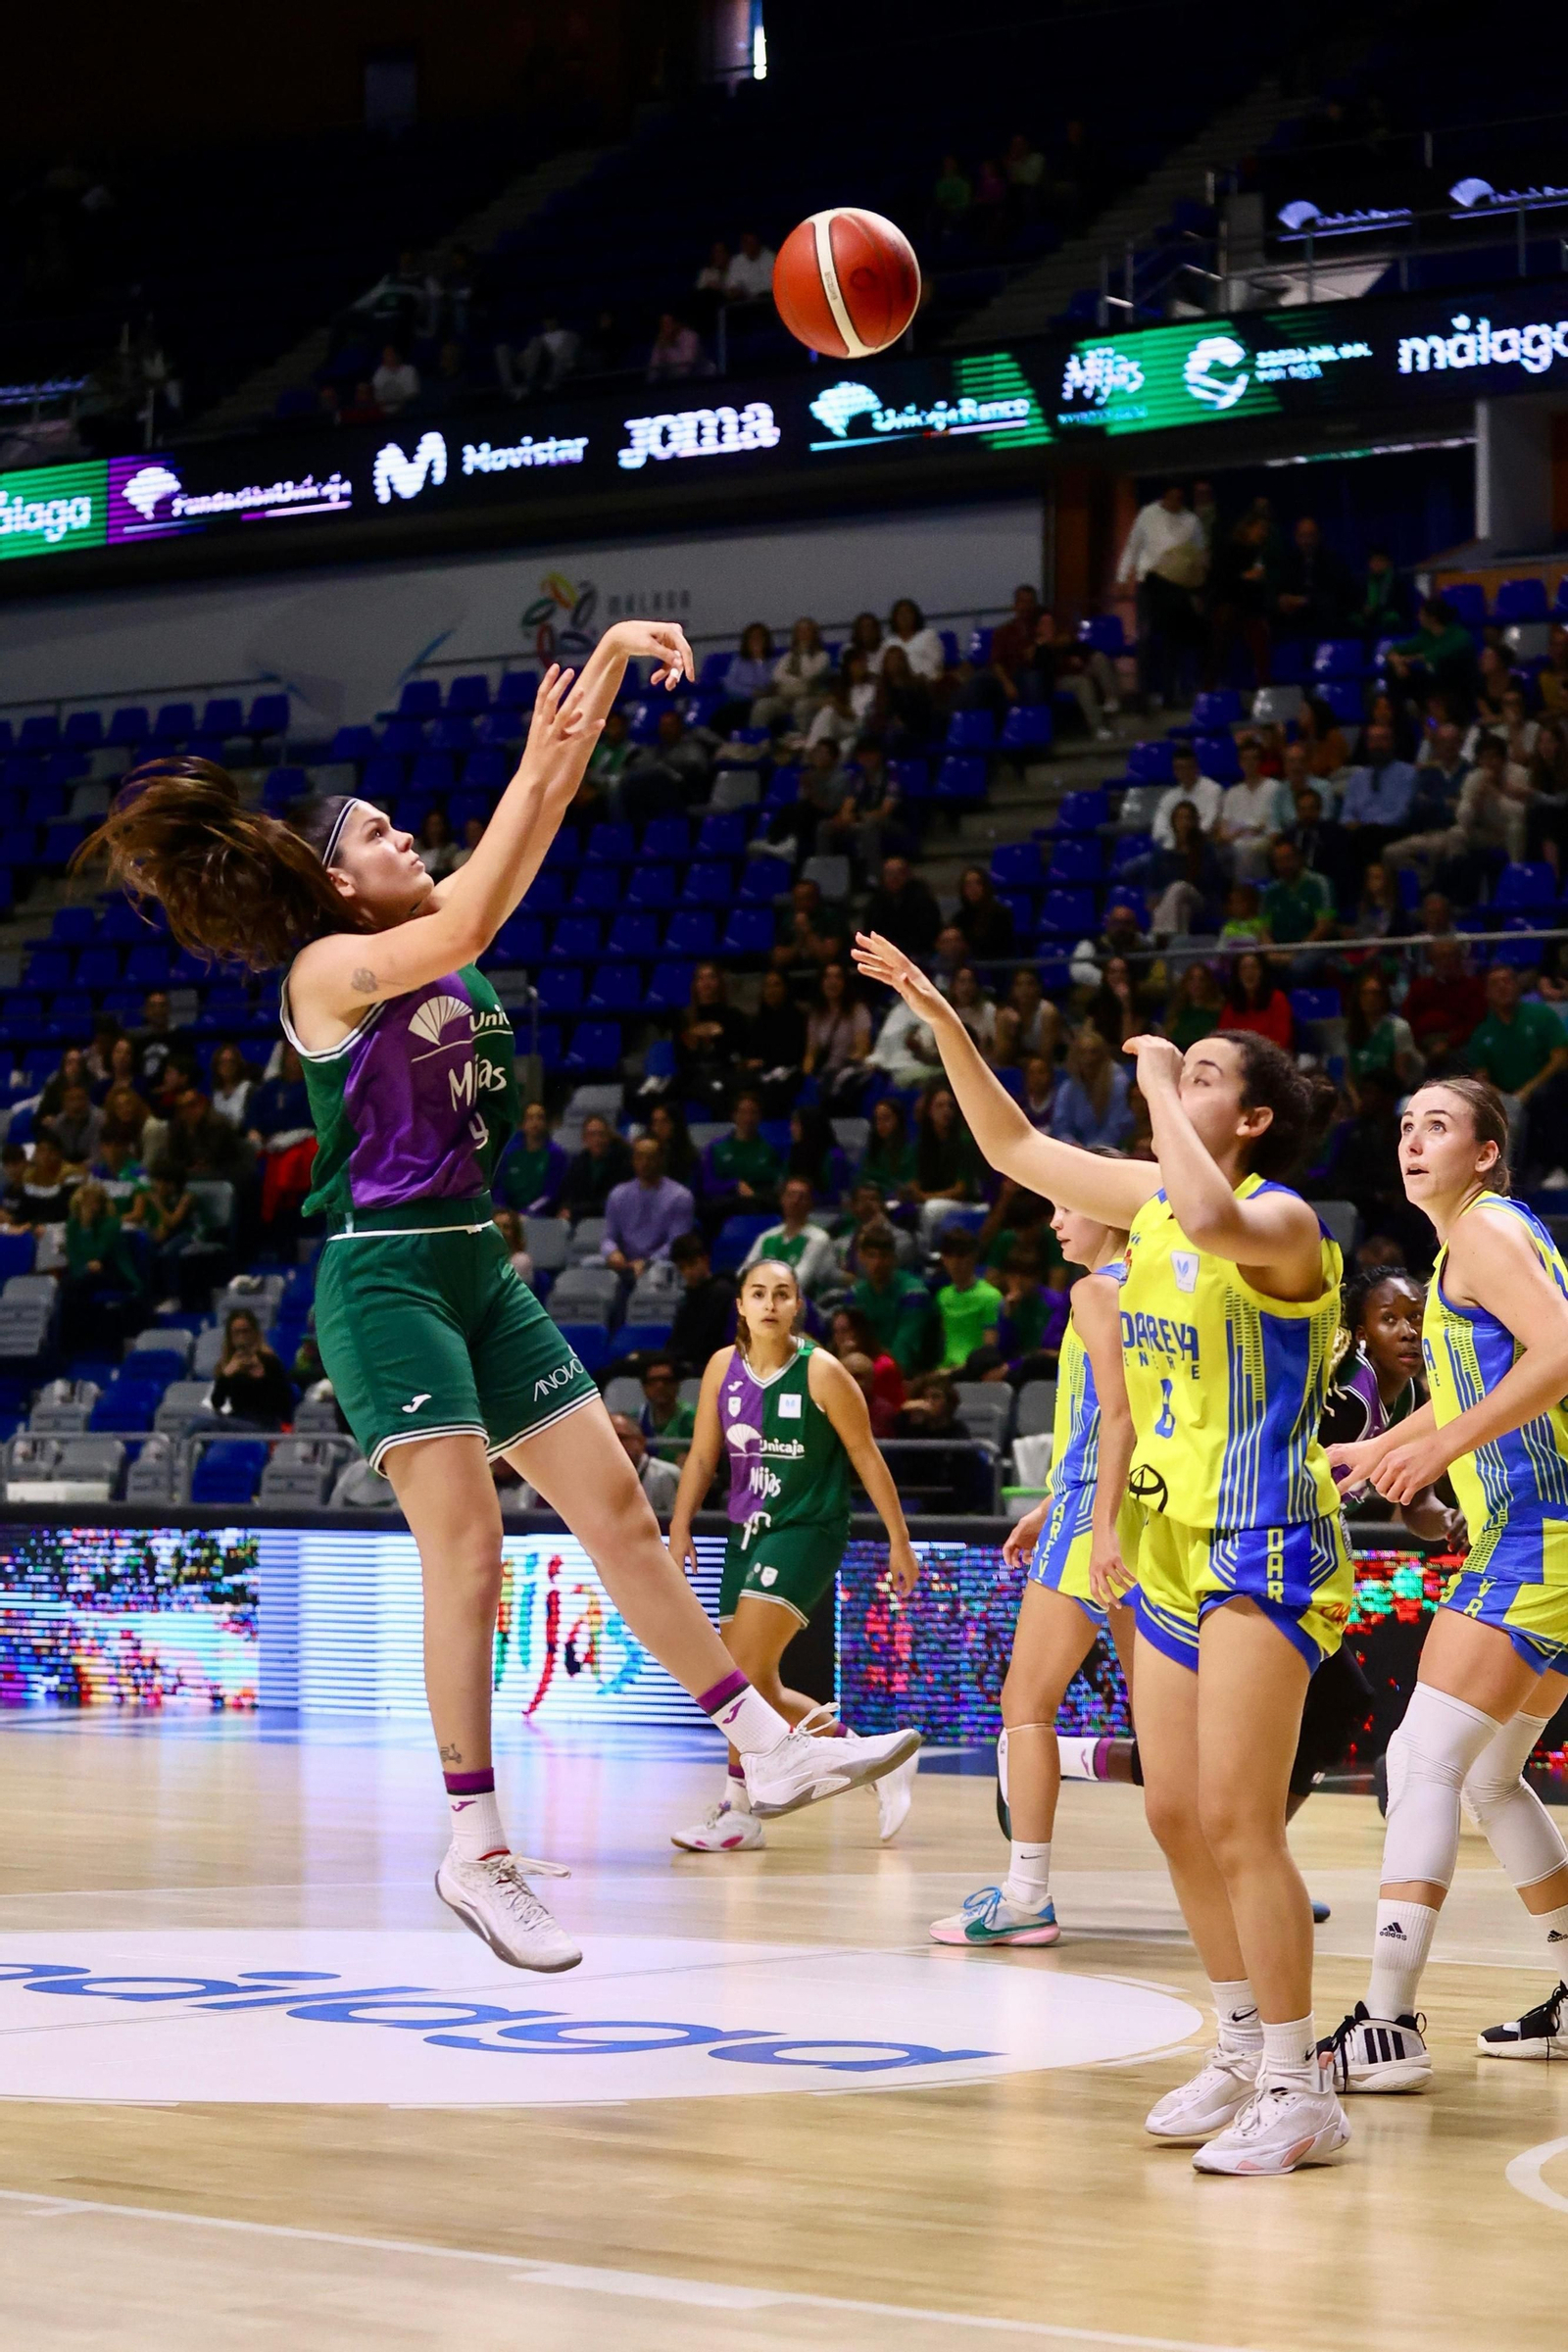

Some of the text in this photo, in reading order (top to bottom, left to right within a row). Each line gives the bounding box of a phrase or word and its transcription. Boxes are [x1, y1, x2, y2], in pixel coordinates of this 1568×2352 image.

[463, 435, 589, 476] Movistar
[448, 1053, 508, 1112] Mjas
[760, 1438, 805, 1457] Unicaja
[749, 1466, 782, 1499] Mijas
[1379, 1931, 1407, 1941] adidas
[0, 1963, 1011, 2074] álaga
